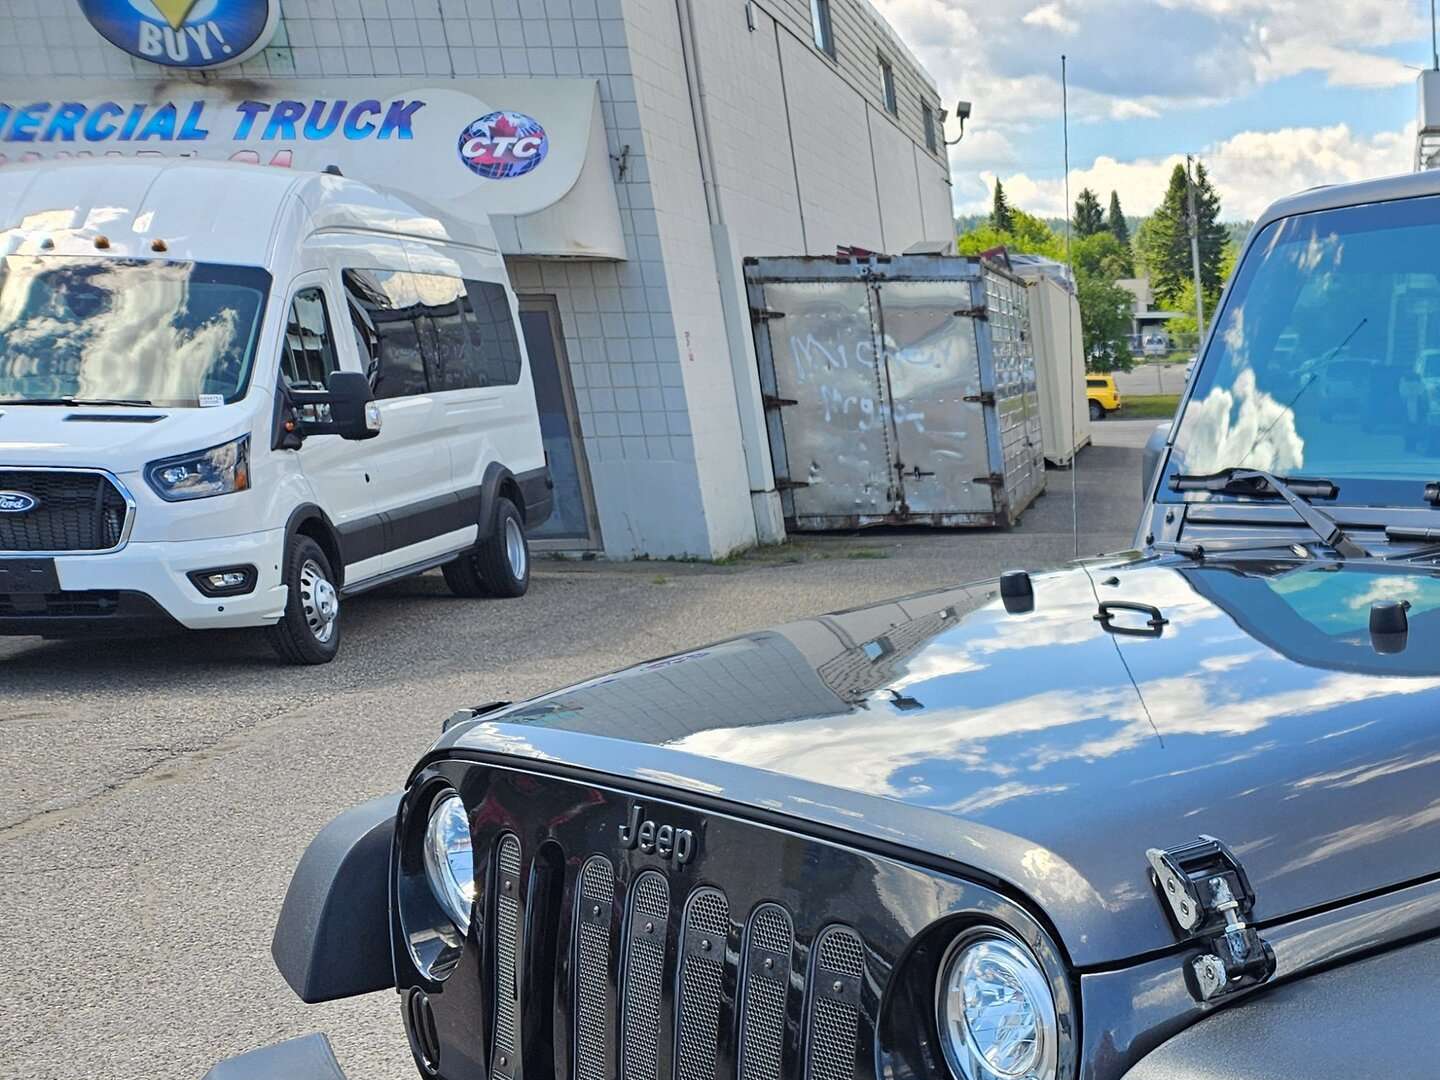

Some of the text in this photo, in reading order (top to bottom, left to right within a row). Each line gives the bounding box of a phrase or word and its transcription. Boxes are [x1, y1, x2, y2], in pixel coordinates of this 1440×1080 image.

[138, 19, 232, 62] BUY!
[0, 99, 427, 142] ERCIAL TRUCK
[461, 136, 542, 158] CTC
[618, 805, 694, 871] Jeep
